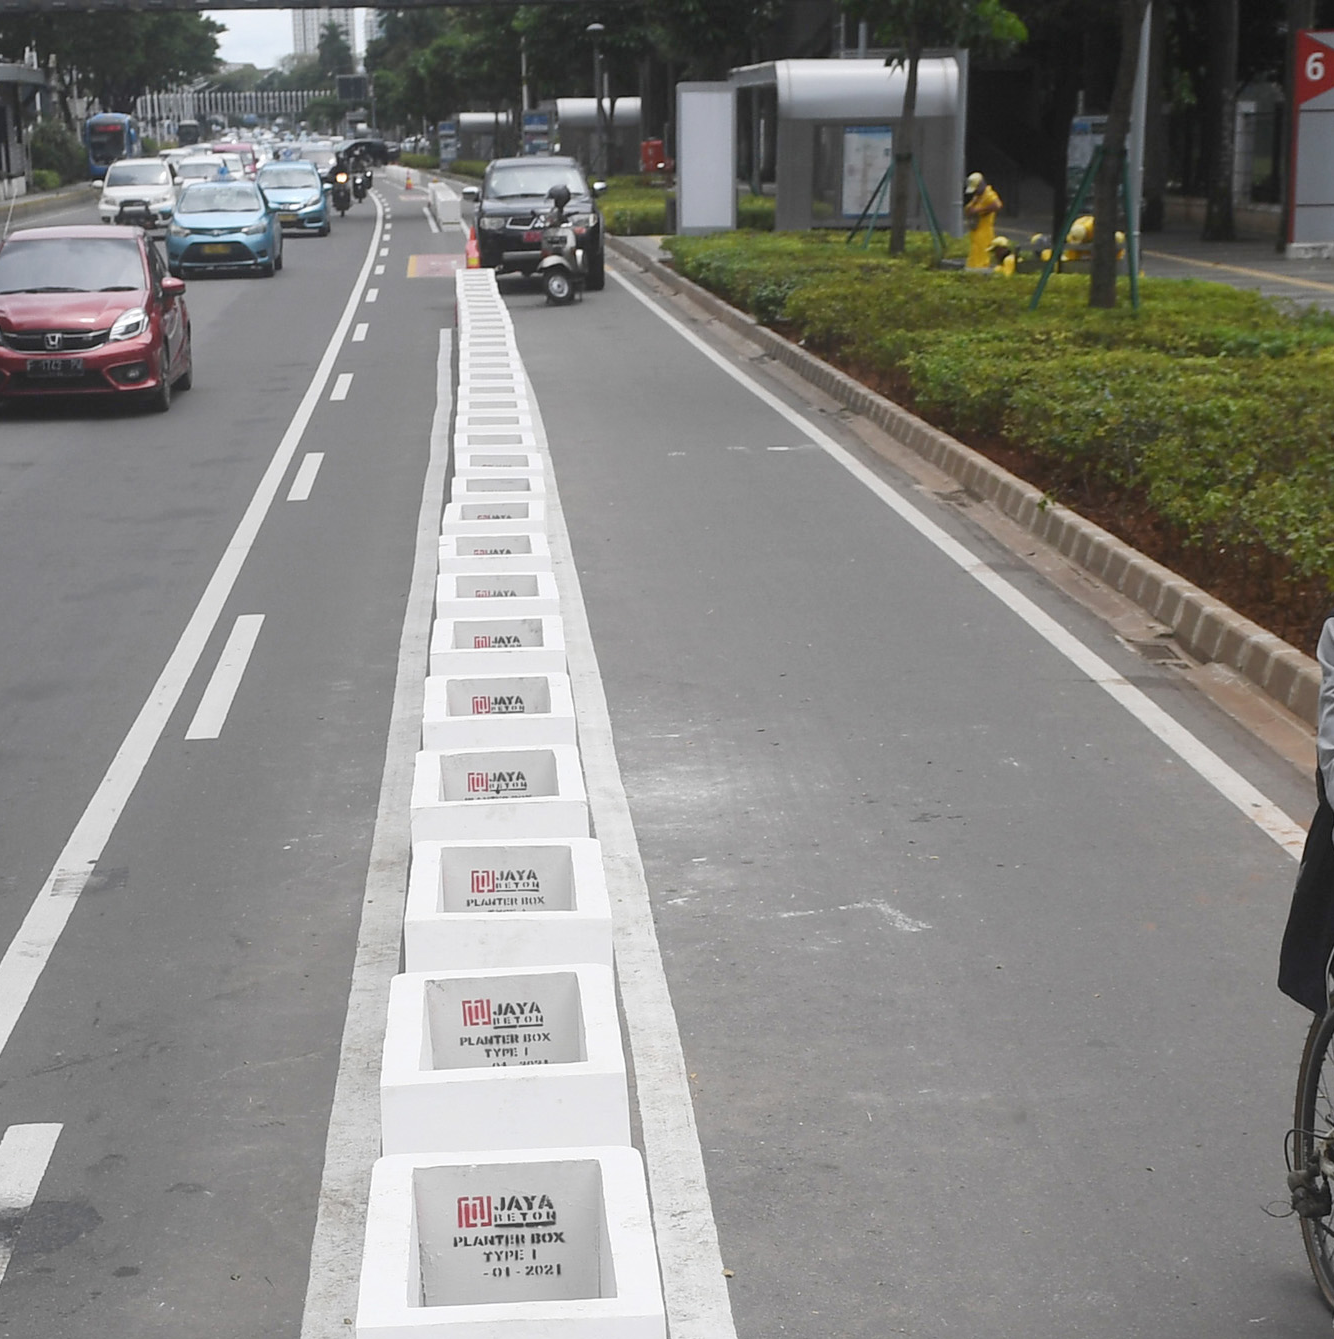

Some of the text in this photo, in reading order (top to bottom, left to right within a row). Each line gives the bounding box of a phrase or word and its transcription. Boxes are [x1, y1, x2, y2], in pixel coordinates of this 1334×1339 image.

[1305, 52, 1325, 81] 6
[491, 590, 517, 598] JAYA
[492, 635, 521, 645] JAYA
[491, 696, 524, 706] JAYA
[489, 771, 526, 782] JAYA
[496, 869, 538, 881] JAYA
[496, 881, 540, 889] BETON
[466, 896, 545, 907] PLANTER BOX
[493, 1001, 541, 1016] JAYA
[493, 1015, 543, 1026] BETON
[459, 1032, 551, 1046] PLANTER BOX
[484, 1047, 518, 1058] TYPE
[494, 1195, 554, 1211] JAYA
[494, 1210, 556, 1223] BETON
[453, 1231, 565, 1247] PLANTER BOX
[483, 1250, 524, 1263] TYPE
